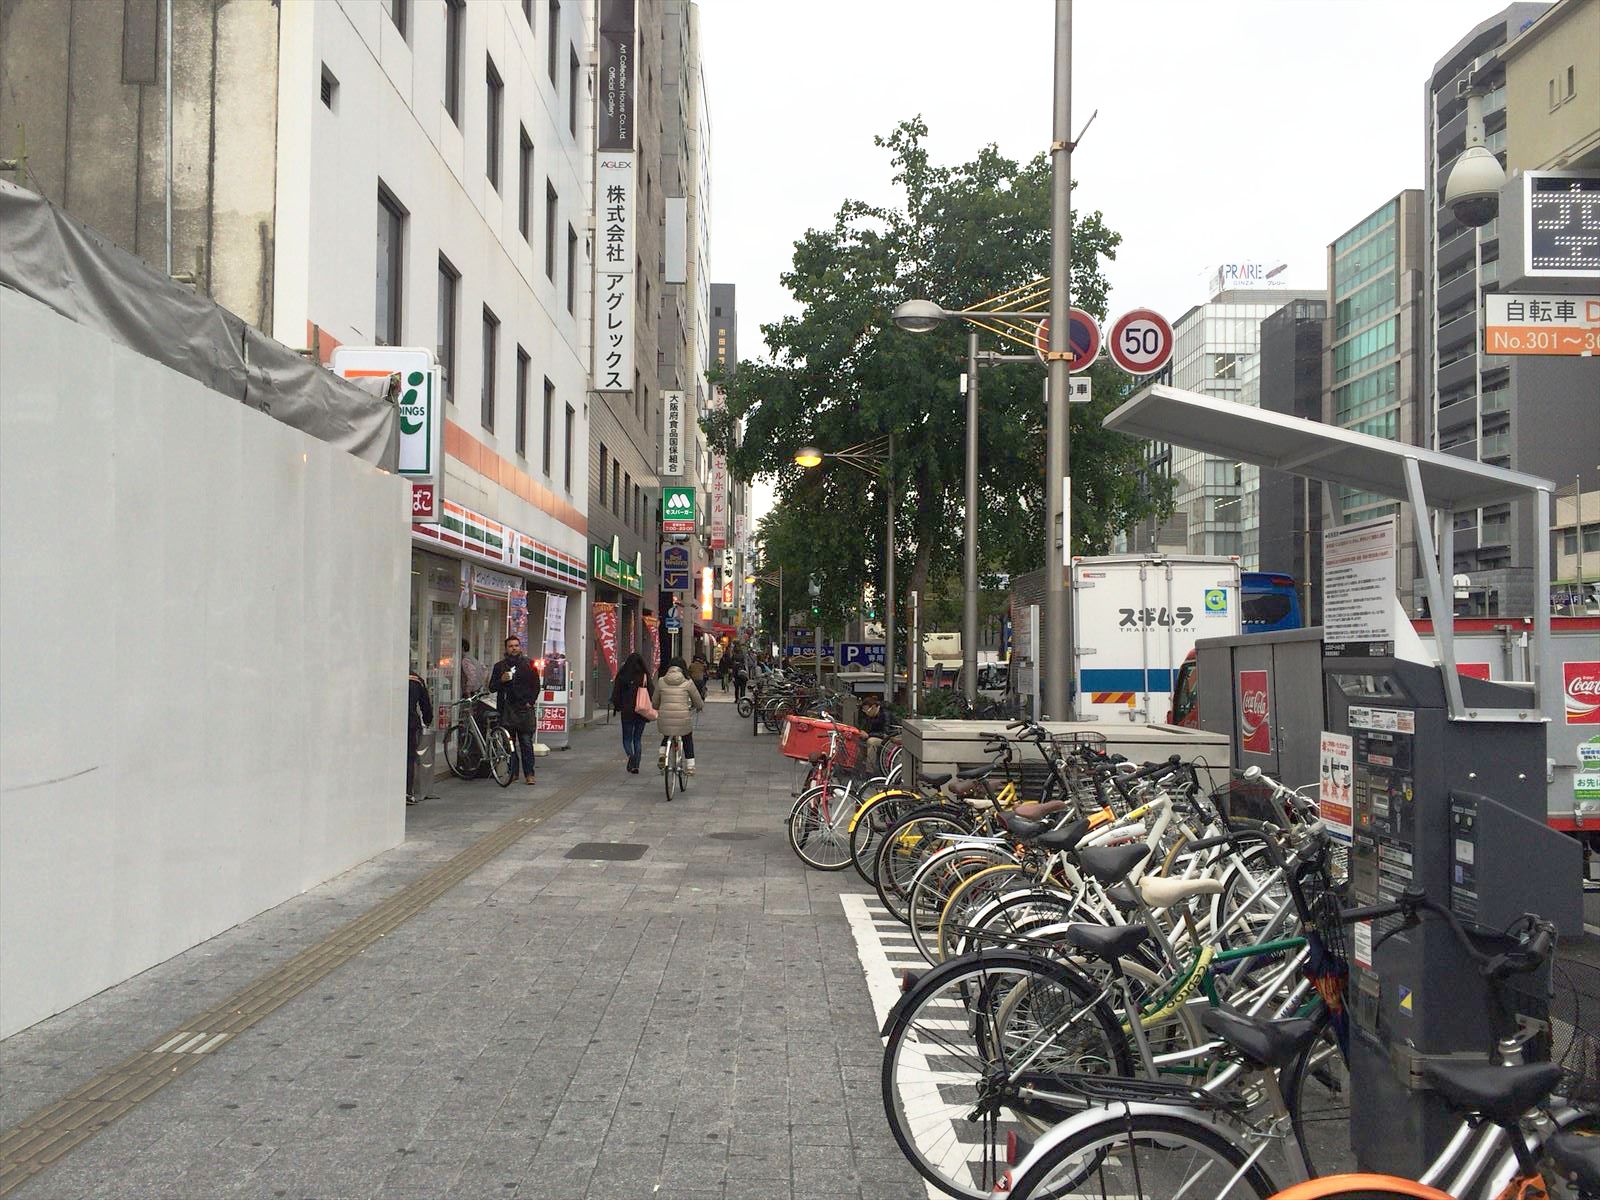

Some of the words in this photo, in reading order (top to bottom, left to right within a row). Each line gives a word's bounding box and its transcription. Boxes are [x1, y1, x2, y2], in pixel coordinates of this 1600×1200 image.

[619, 43, 627, 54] Art
[619, 55, 627, 90] Collection
[607, 92, 616, 118] Gallery
[619, 90, 627, 113] House
[600, 161, 632, 169] AGLEX
[606, 184, 626, 263] 株式会社
[1506, 299, 1577, 323] 自転車
[1125, 328, 1159, 355] 50
[1118, 606, 1194, 627] スギムラ
[847, 646, 859, 661] P
